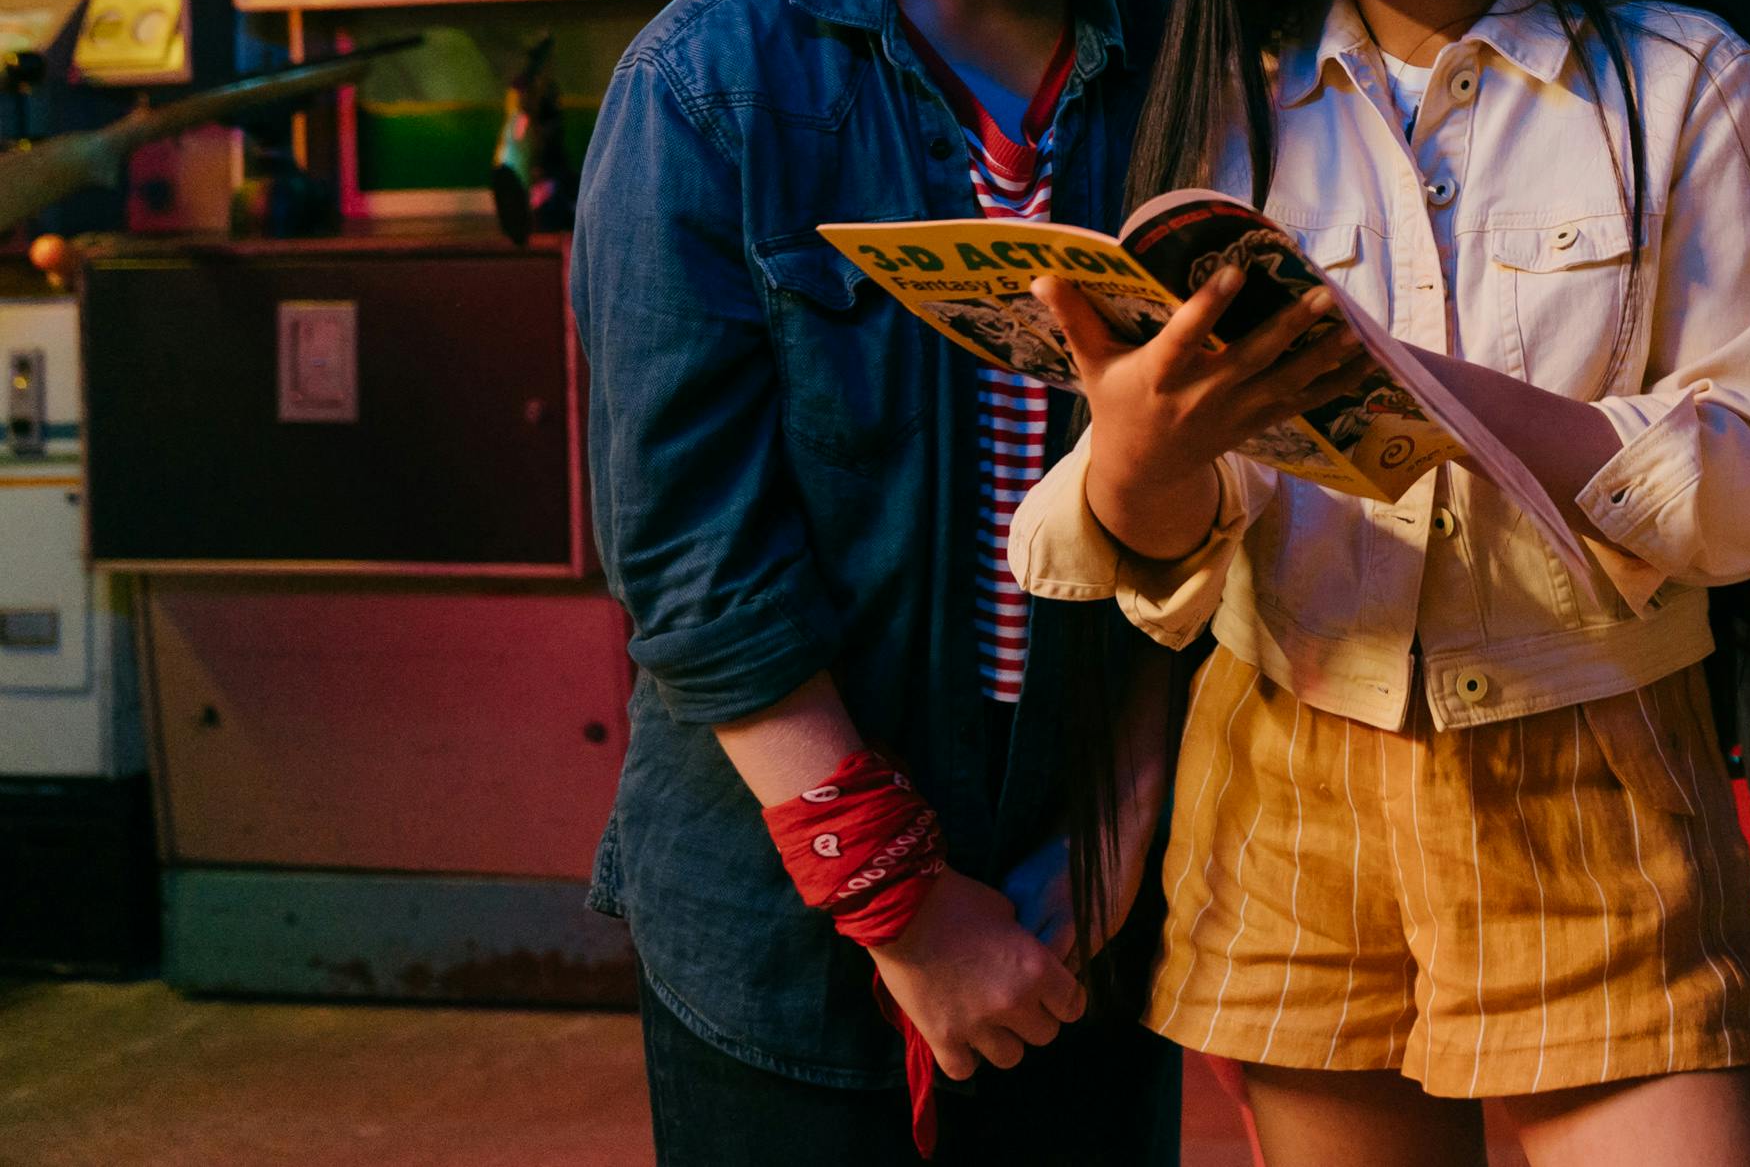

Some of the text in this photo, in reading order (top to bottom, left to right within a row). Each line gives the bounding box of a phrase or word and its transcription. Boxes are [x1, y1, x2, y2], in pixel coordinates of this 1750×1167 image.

[858, 242, 1148, 280] 3-D ACTION
[889, 275, 993, 296] Fantasy
[1000, 276, 1019, 290] &
